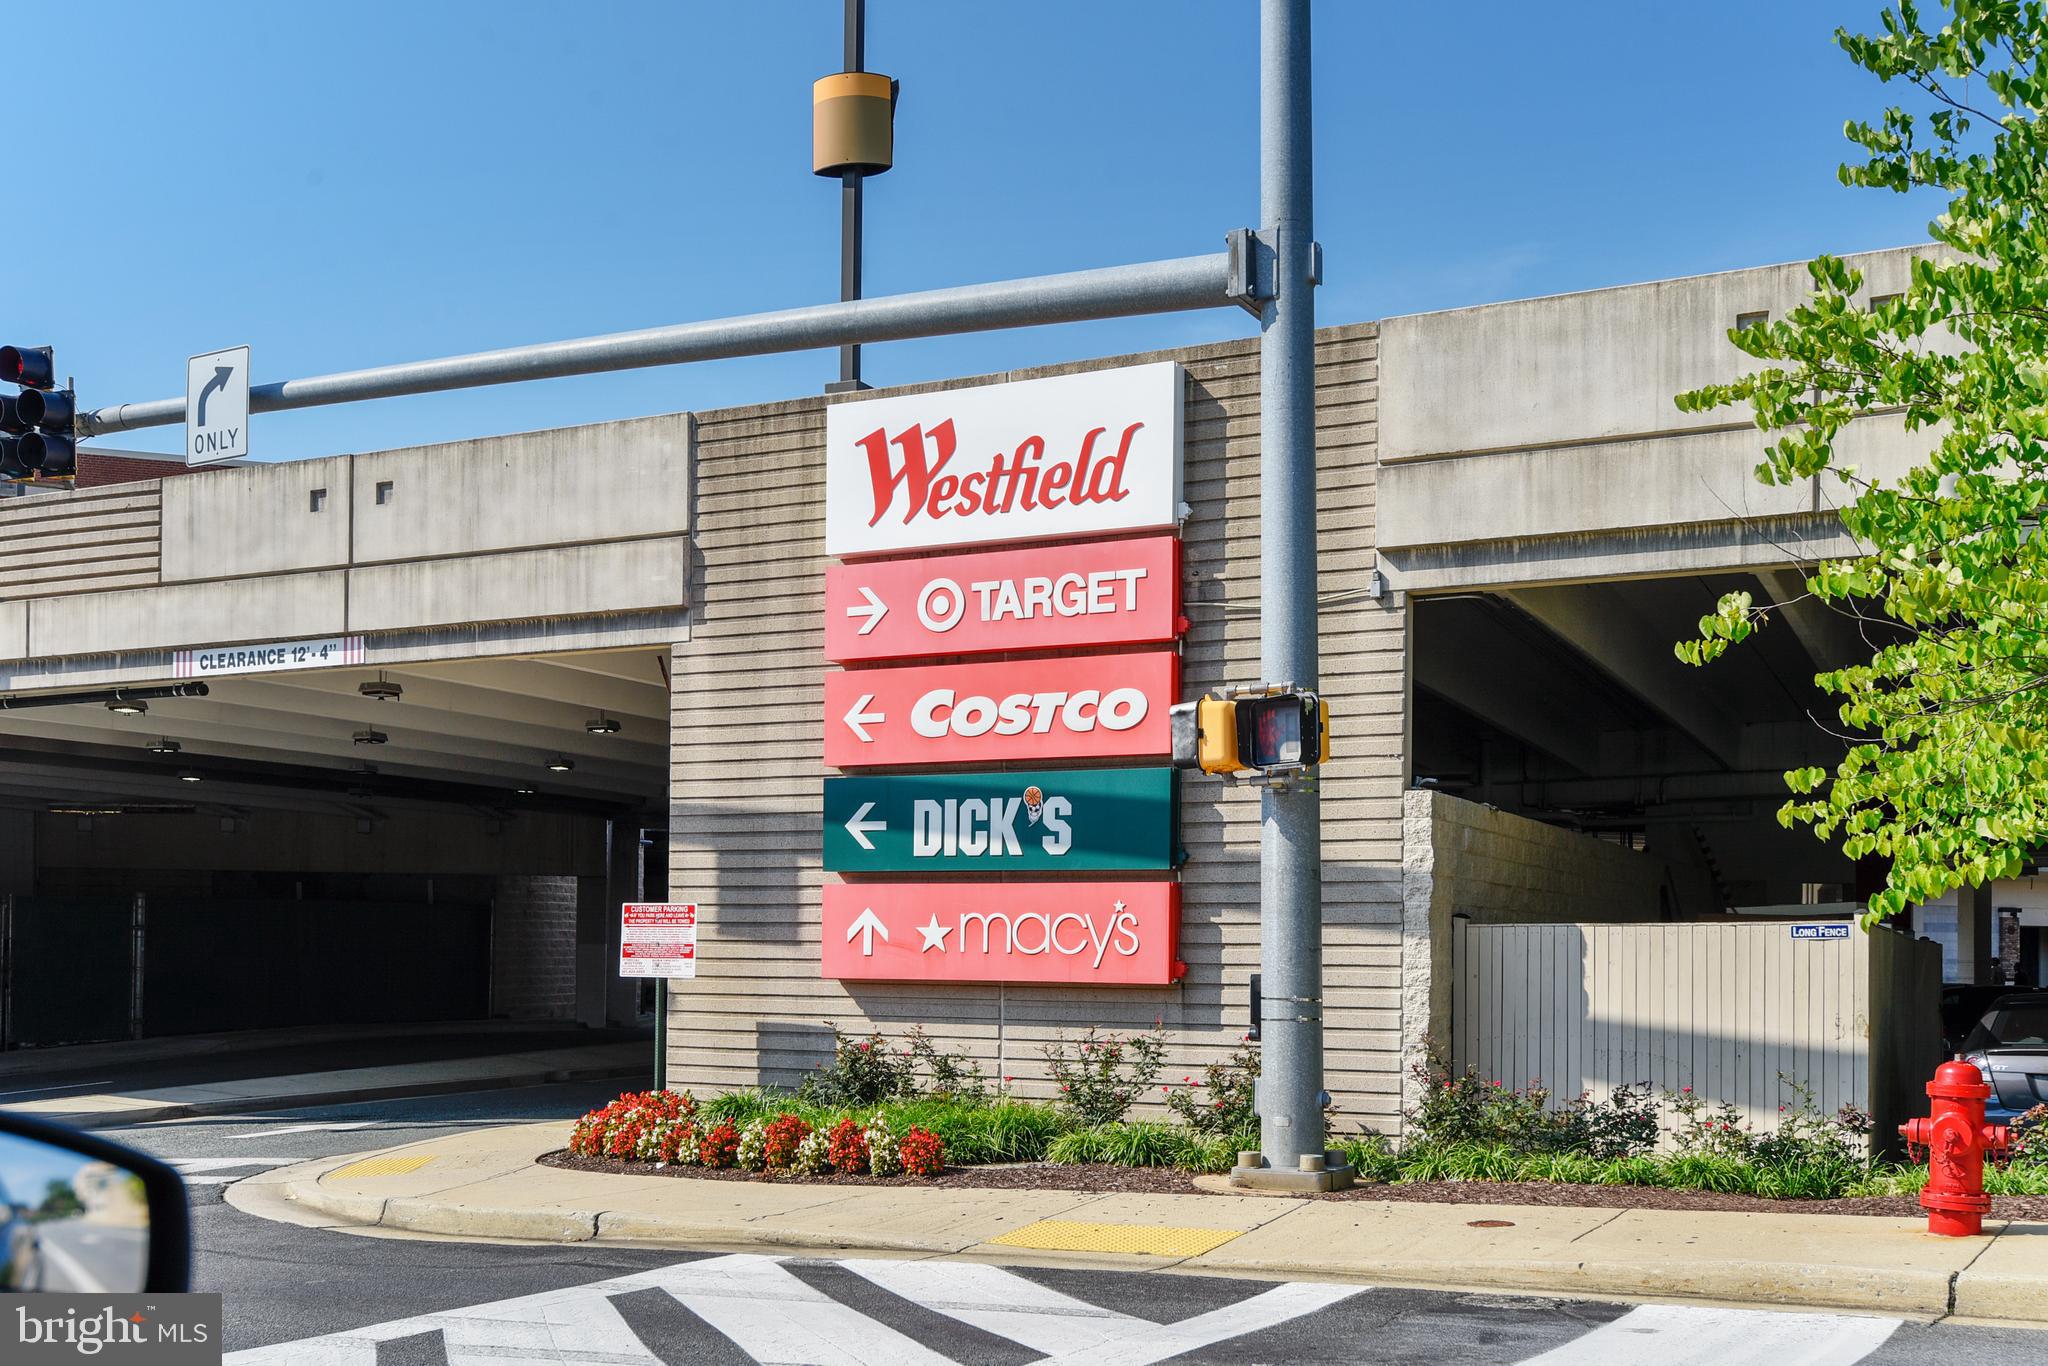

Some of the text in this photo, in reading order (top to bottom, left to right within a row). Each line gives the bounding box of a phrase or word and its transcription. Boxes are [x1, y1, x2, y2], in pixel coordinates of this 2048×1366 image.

[195, 427, 239, 454] ONLY
[854, 417, 1145, 528] Westfield
[971, 567, 1148, 622] TARGET
[200, 648, 286, 670] CLEARANCE
[910, 687, 1149, 738] COSTCO
[913, 785, 1073, 858] DICK'S
[630, 905, 689, 913] CUSTOMER PARKING
[959, 898, 1140, 969] macy's
[1792, 926, 1847, 937] LONG FENCE
